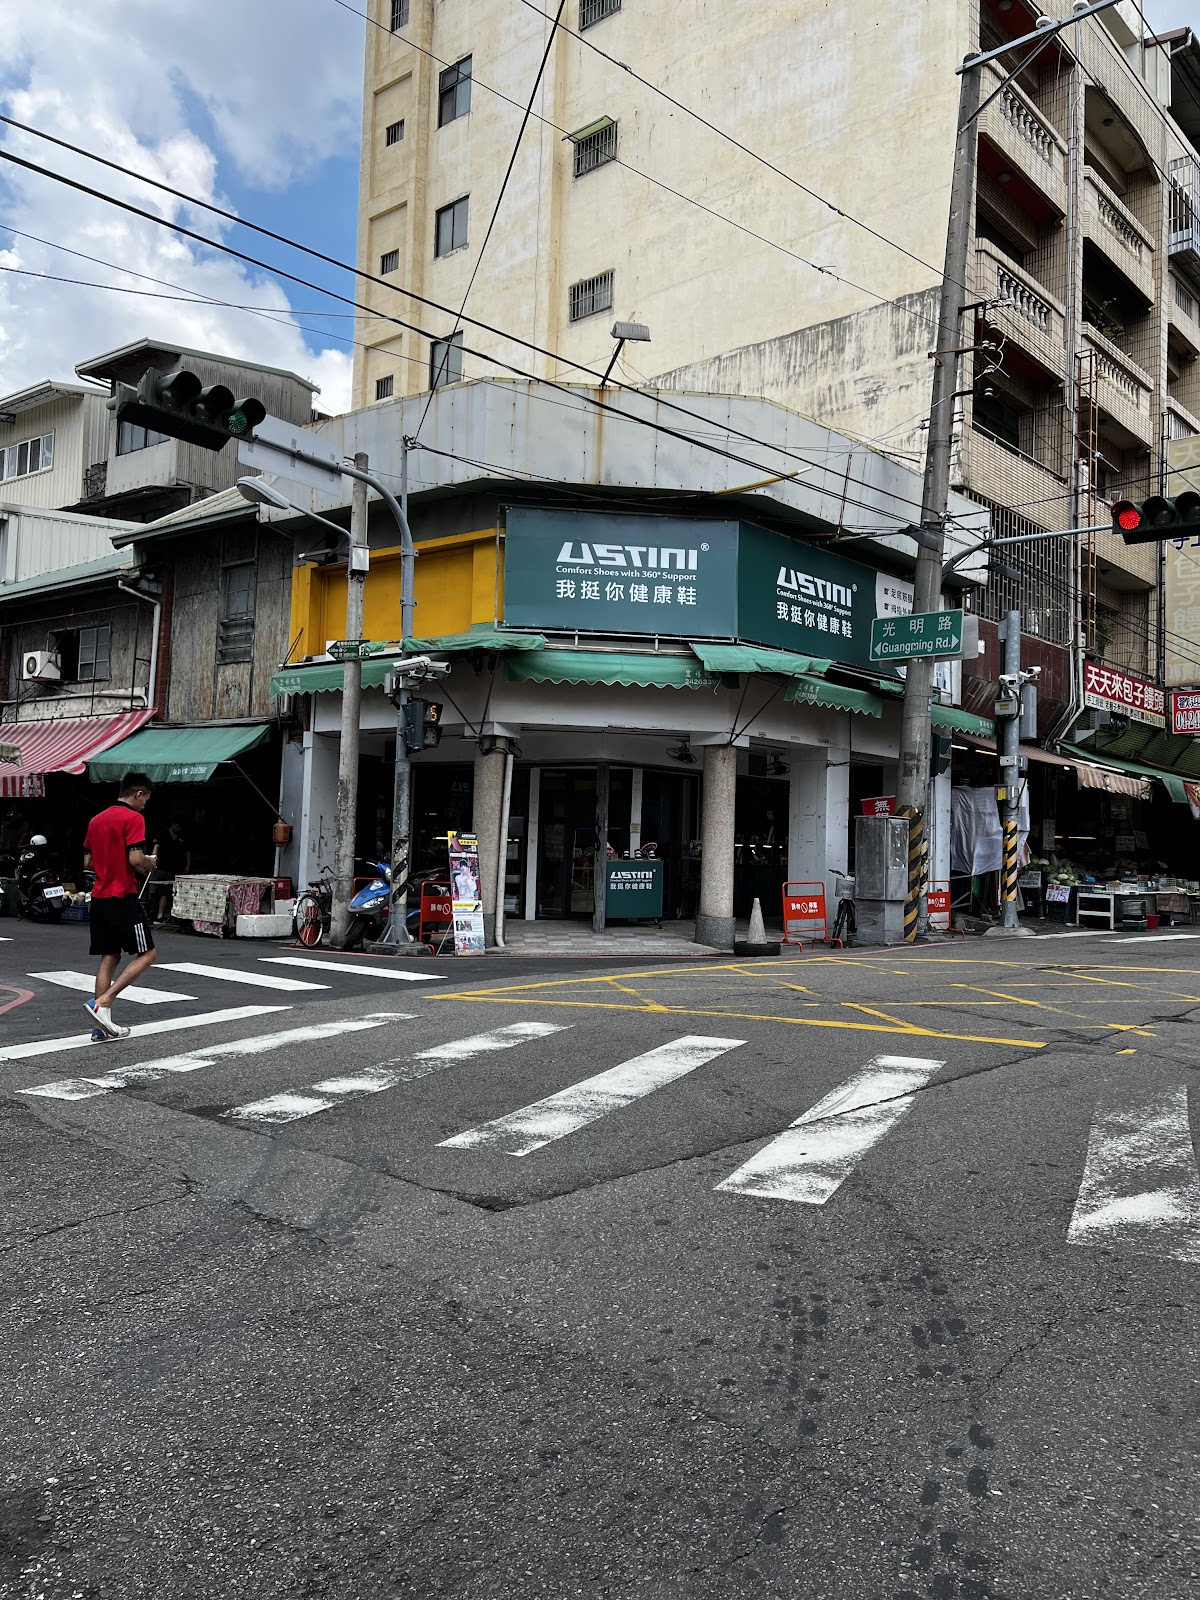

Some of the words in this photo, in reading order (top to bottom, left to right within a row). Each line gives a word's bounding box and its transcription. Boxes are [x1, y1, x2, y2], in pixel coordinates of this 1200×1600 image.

[556, 565, 592, 575] Comfort
[594, 568, 619, 577] Shoes
[620, 570, 640, 578] with
[663, 572, 697, 583] Support
[555, 579, 697, 606] 我挺你健康鞋
[776, 588, 797, 600] Comfort
[798, 594, 812, 604] Shoes
[812, 599, 823, 608] with
[833, 605, 852, 617] Support
[776, 601, 853, 639] 我挺你健康鞋
[882, 615, 953, 638] 光明路
[881, 639, 934, 655] Guangming
[935, 637, 951, 649] Rd.
[1087, 665, 1165, 714] 天天來包子饅頭
